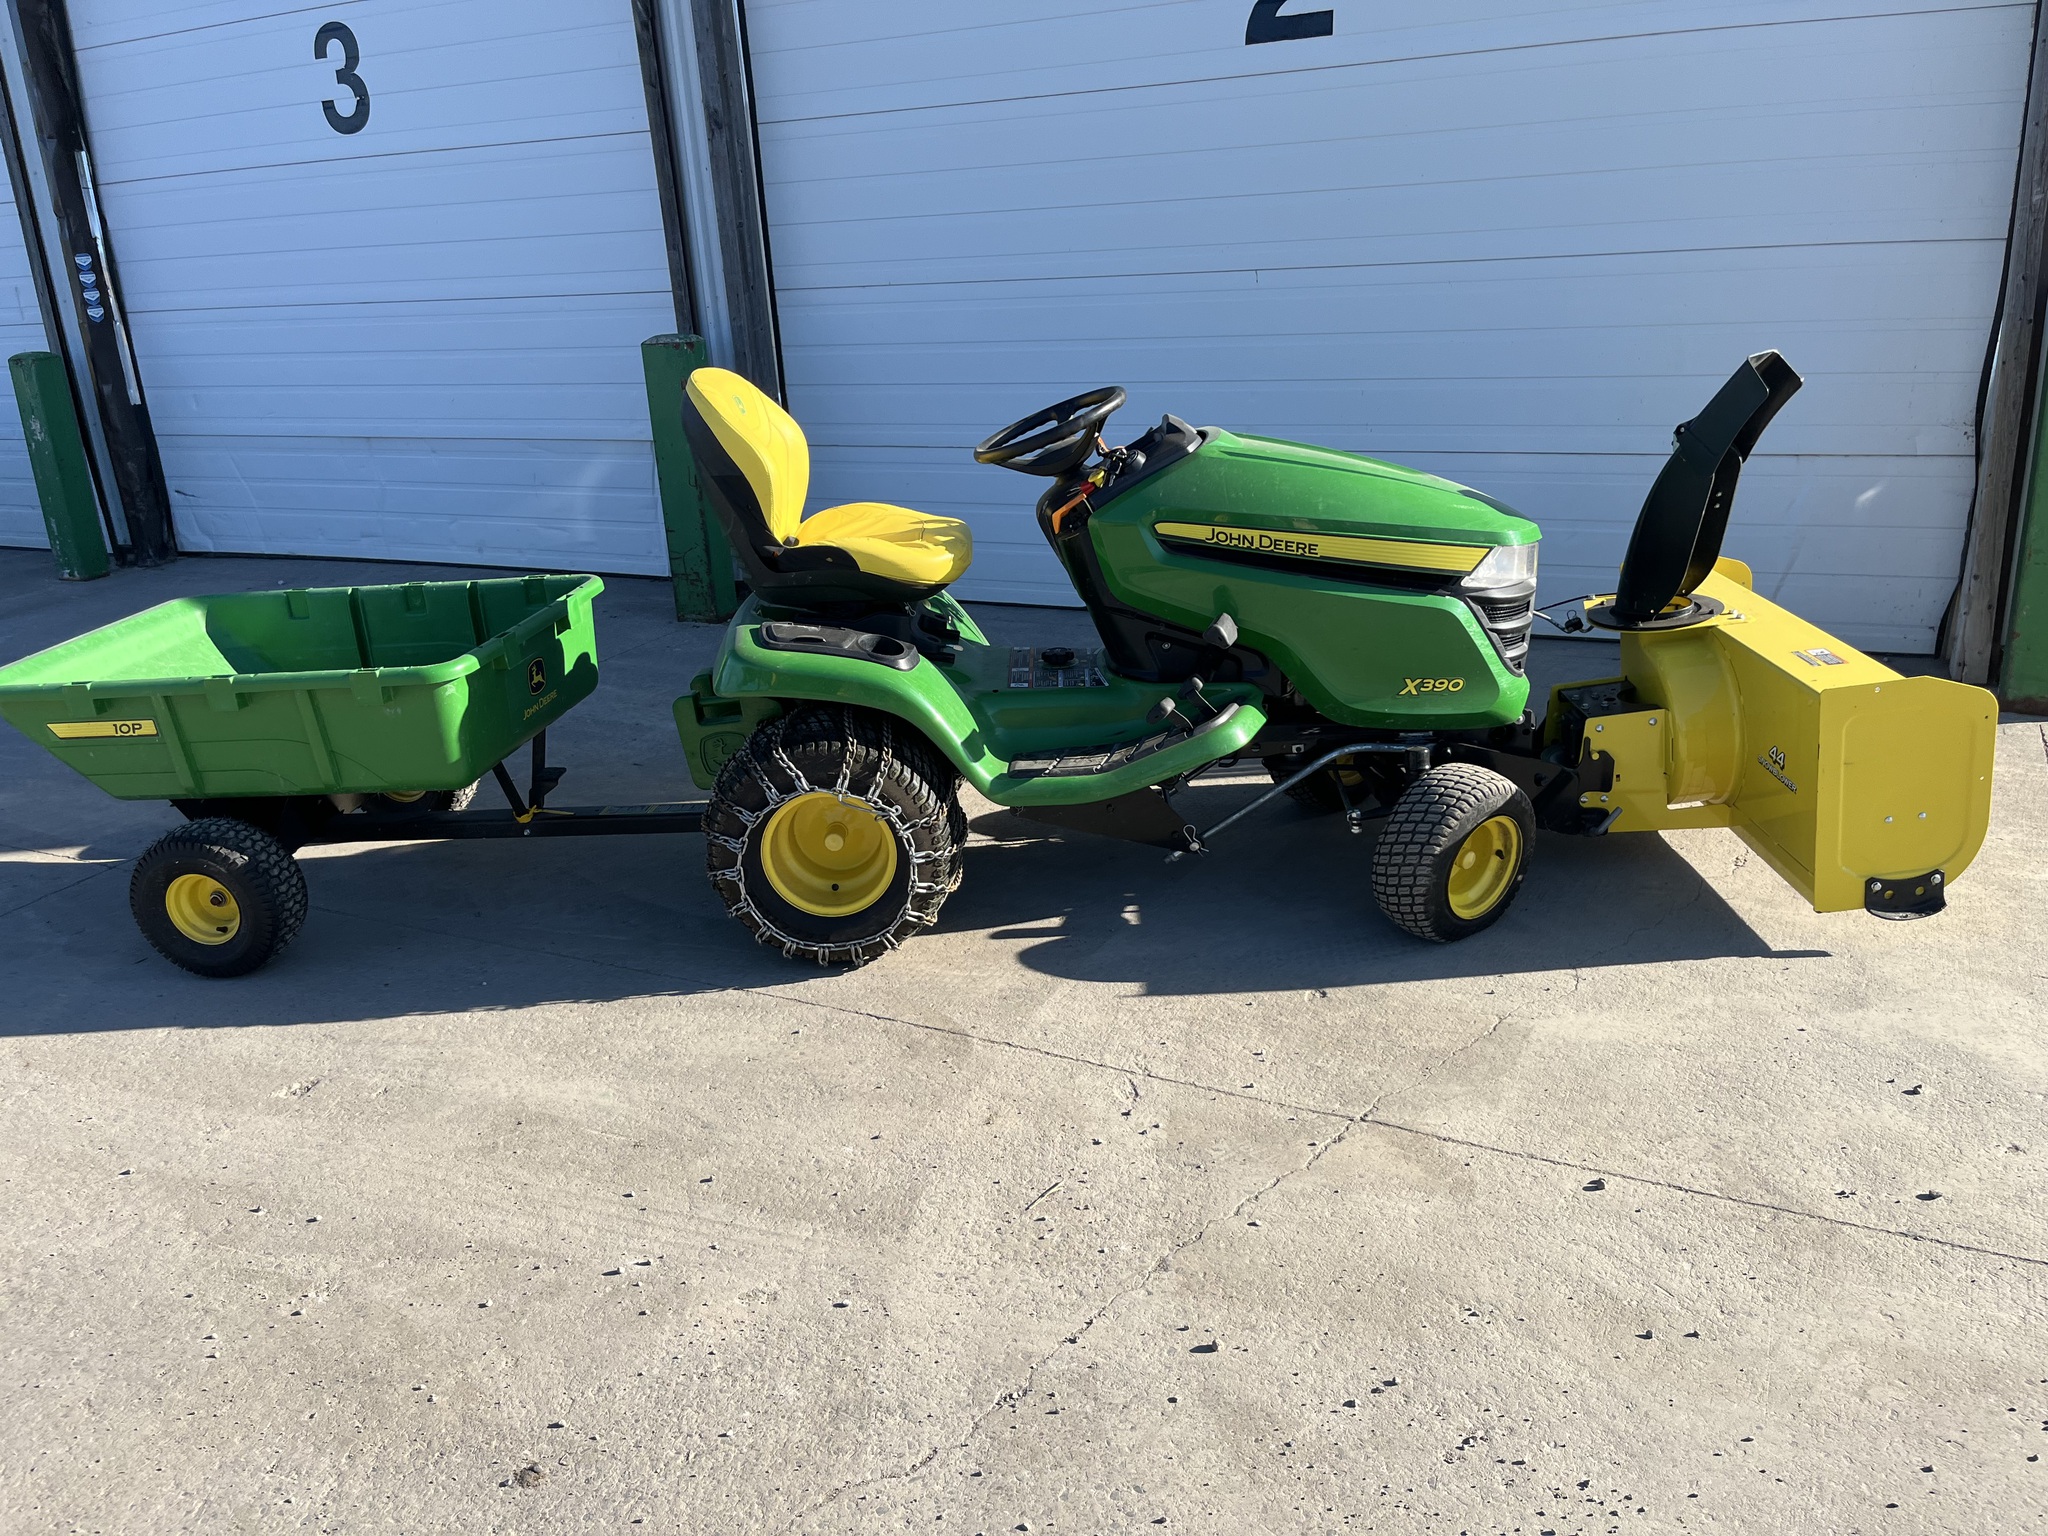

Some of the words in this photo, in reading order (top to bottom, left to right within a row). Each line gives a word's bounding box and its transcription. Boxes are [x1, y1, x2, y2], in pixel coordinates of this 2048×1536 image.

[313, 21, 370, 135] 3
[1205, 528, 1255, 548] JOHN
[1259, 534, 1319, 556] DEERE
[1398, 677, 1465, 696] X390
[523, 703, 539, 720] JOHN
[539, 689, 557, 709] DEERE
[112, 723, 143, 736] 10P
[1768, 745, 1785, 771] 44
[1758, 755, 1797, 794] SNOWBLOWER
